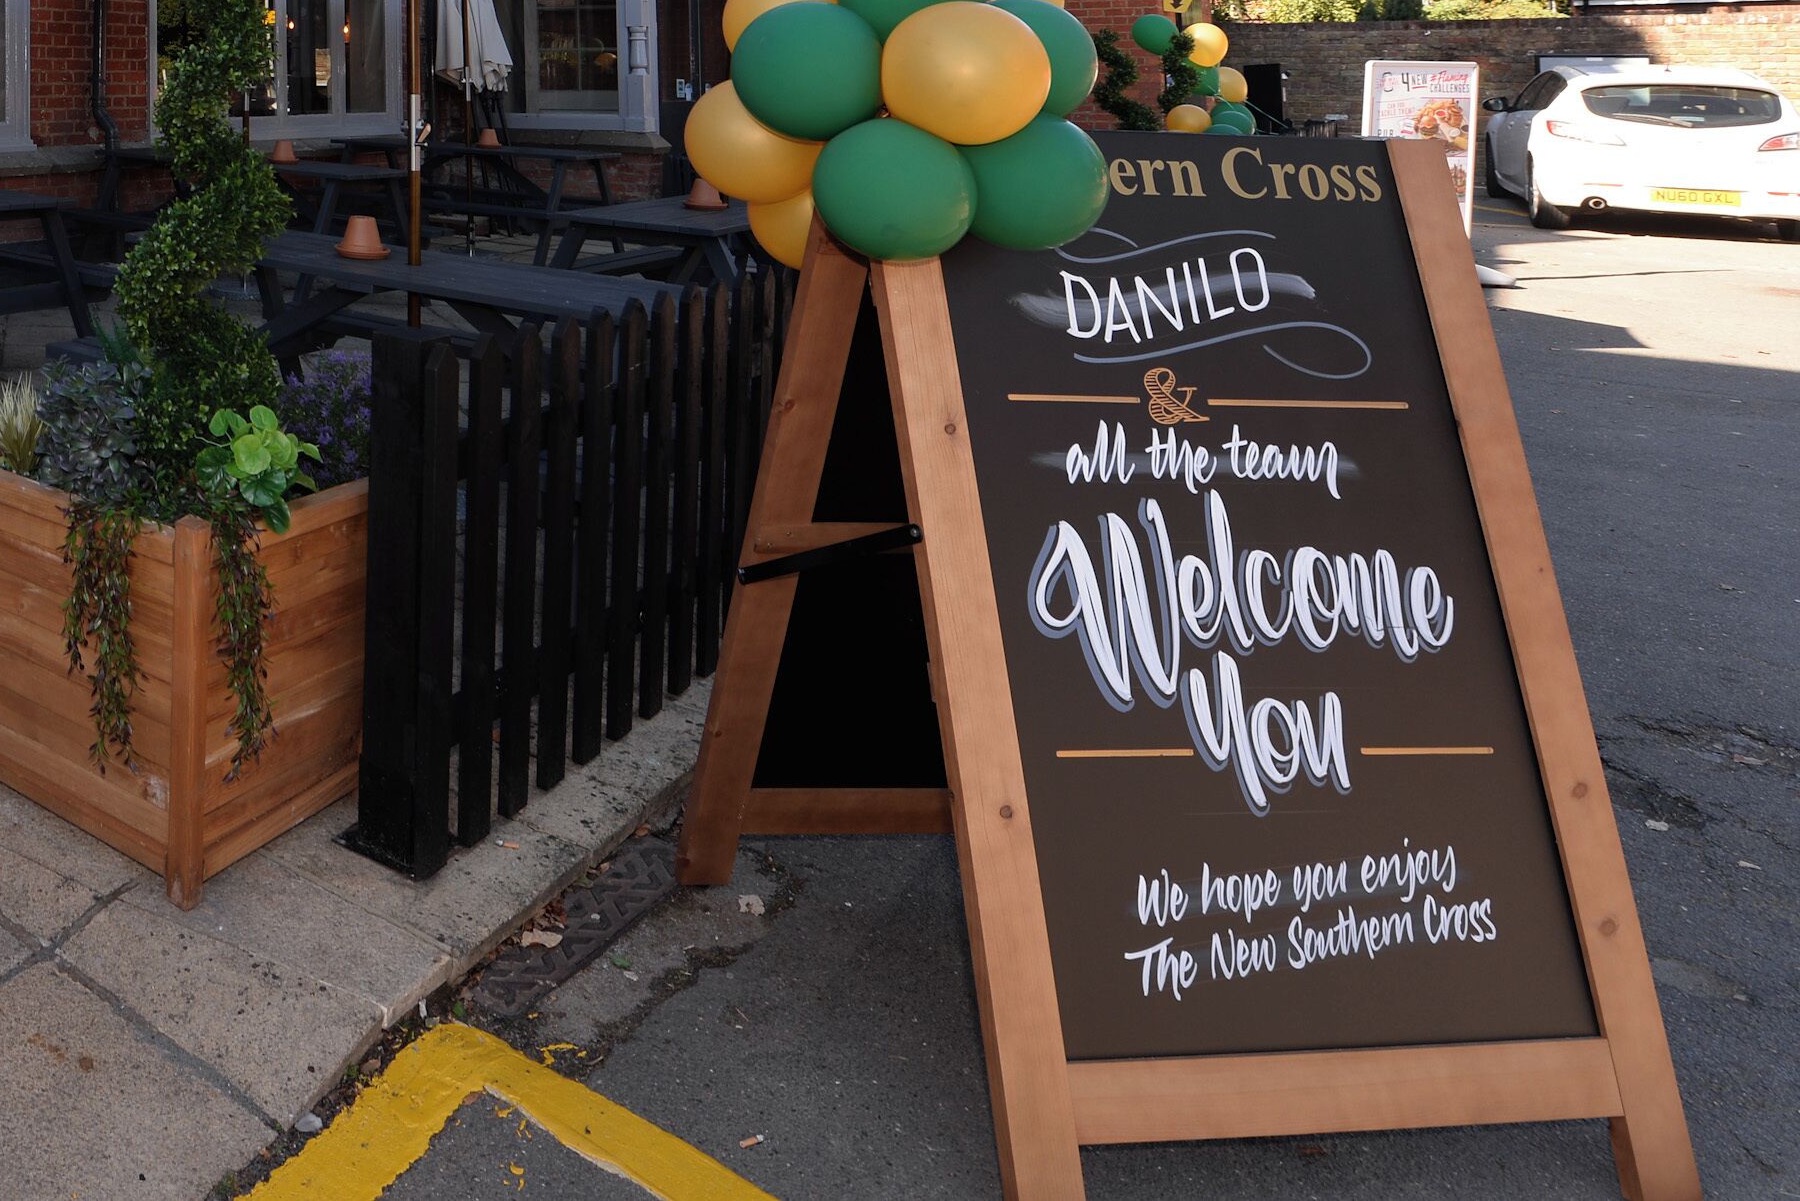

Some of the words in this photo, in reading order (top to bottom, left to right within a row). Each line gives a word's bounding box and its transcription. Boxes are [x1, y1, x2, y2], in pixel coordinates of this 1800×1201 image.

[1401, 72, 1410, 92] 4
[1411, 74, 1428, 84] NEW
[1430, 83, 1470, 93] CHALLENGES
[1221, 146, 1382, 202] Cross
[1656, 190, 1698, 202] NU60
[1703, 192, 1734, 204] GXL
[1059, 247, 1271, 344] DANILO
[1143, 367, 1210, 425] &
[1066, 419, 1135, 485] all
[1145, 427, 1218, 495] the
[1222, 424, 1341, 499] team
[1028, 489, 1454, 710] Welcome
[1181, 650, 1352, 810] You
[1137, 869, 1189, 927] We
[1202, 862, 1282, 922] hope
[1293, 861, 1347, 912] you
[1361, 837, 1457, 902] enjoy
[1124, 937, 1198, 1001] The
[1211, 928, 1277, 981] New
[1288, 906, 1414, 969] Southern
[1424, 894, 1496, 945] Cross
